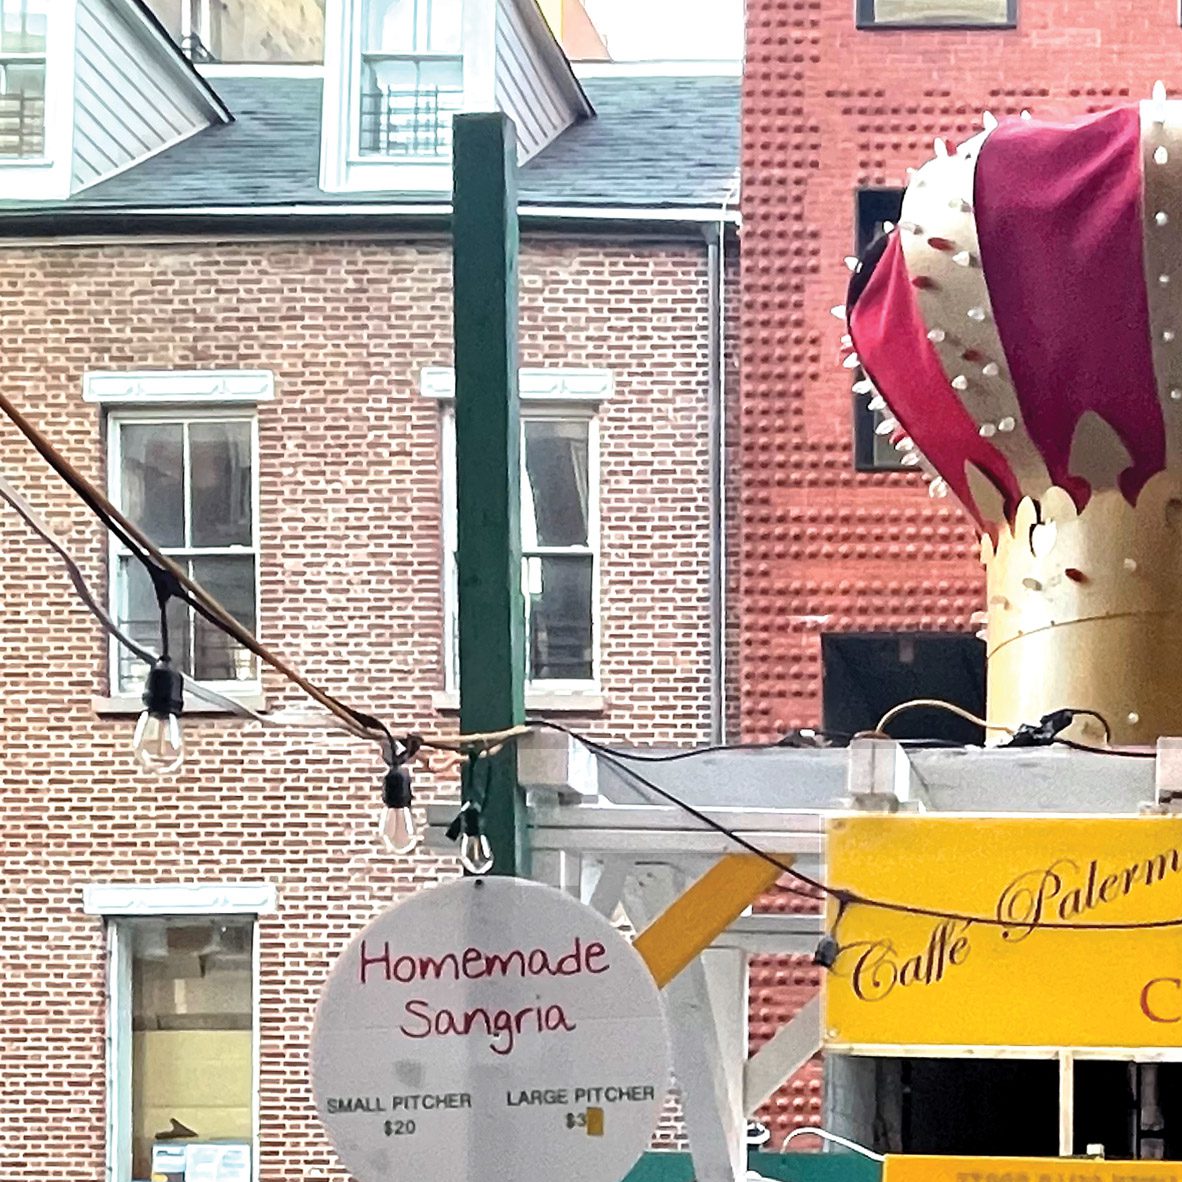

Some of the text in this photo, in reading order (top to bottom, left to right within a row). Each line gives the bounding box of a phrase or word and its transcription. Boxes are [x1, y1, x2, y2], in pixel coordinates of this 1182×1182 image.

[360, 937, 610, 987] Homemade
[401, 1000, 576, 1055] Sangria
[327, 1092, 472, 1114] SMALL PITCHER
[506, 1085, 655, 1106] LARGE PITCHER
[383, 1119, 417, 1137] $20
